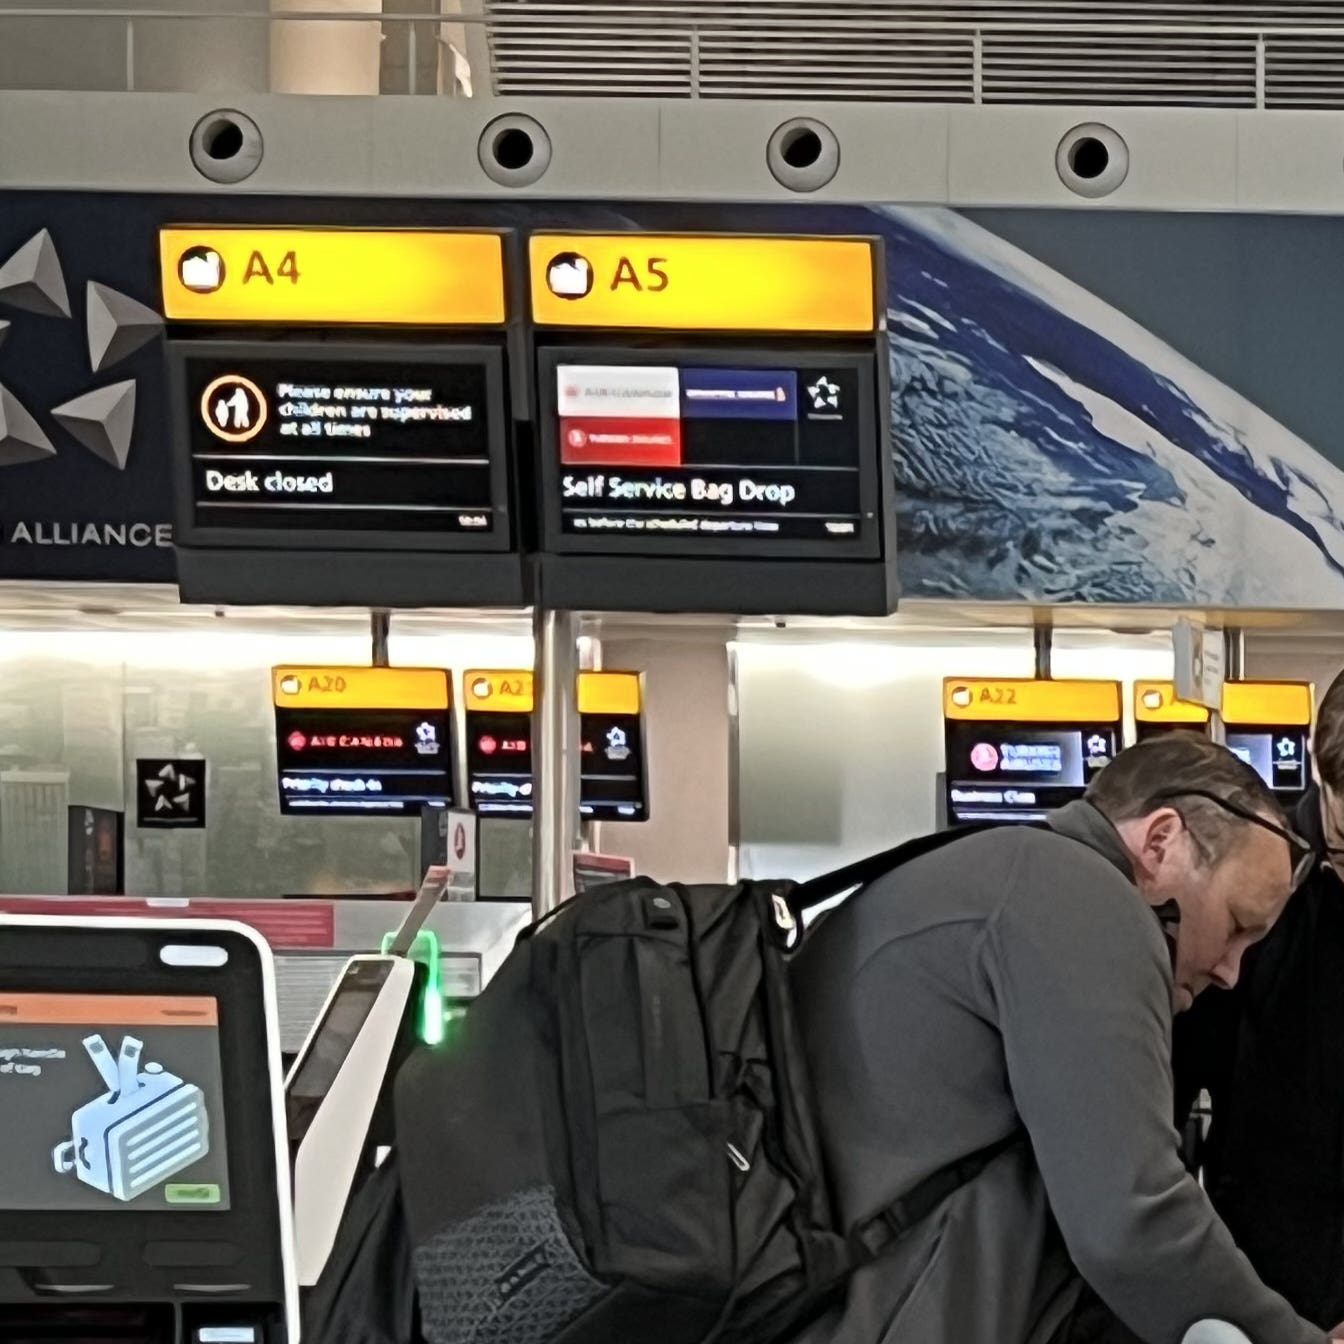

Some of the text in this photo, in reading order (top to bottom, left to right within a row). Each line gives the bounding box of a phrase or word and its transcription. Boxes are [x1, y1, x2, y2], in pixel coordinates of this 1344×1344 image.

[242, 250, 301, 285] A4
[610, 257, 670, 292] A5
[276, 383, 432, 405] Please ensure your
[278, 402, 473, 424] children are supervised
[279, 422, 371, 438] at all times
[206, 470, 334, 493] Desk closed
[562, 475, 796, 507] Self Service Bag Drop
[10, 521, 175, 548] ALLIANCE
[307, 675, 347, 692] A20
[979, 687, 1017, 705] A22
